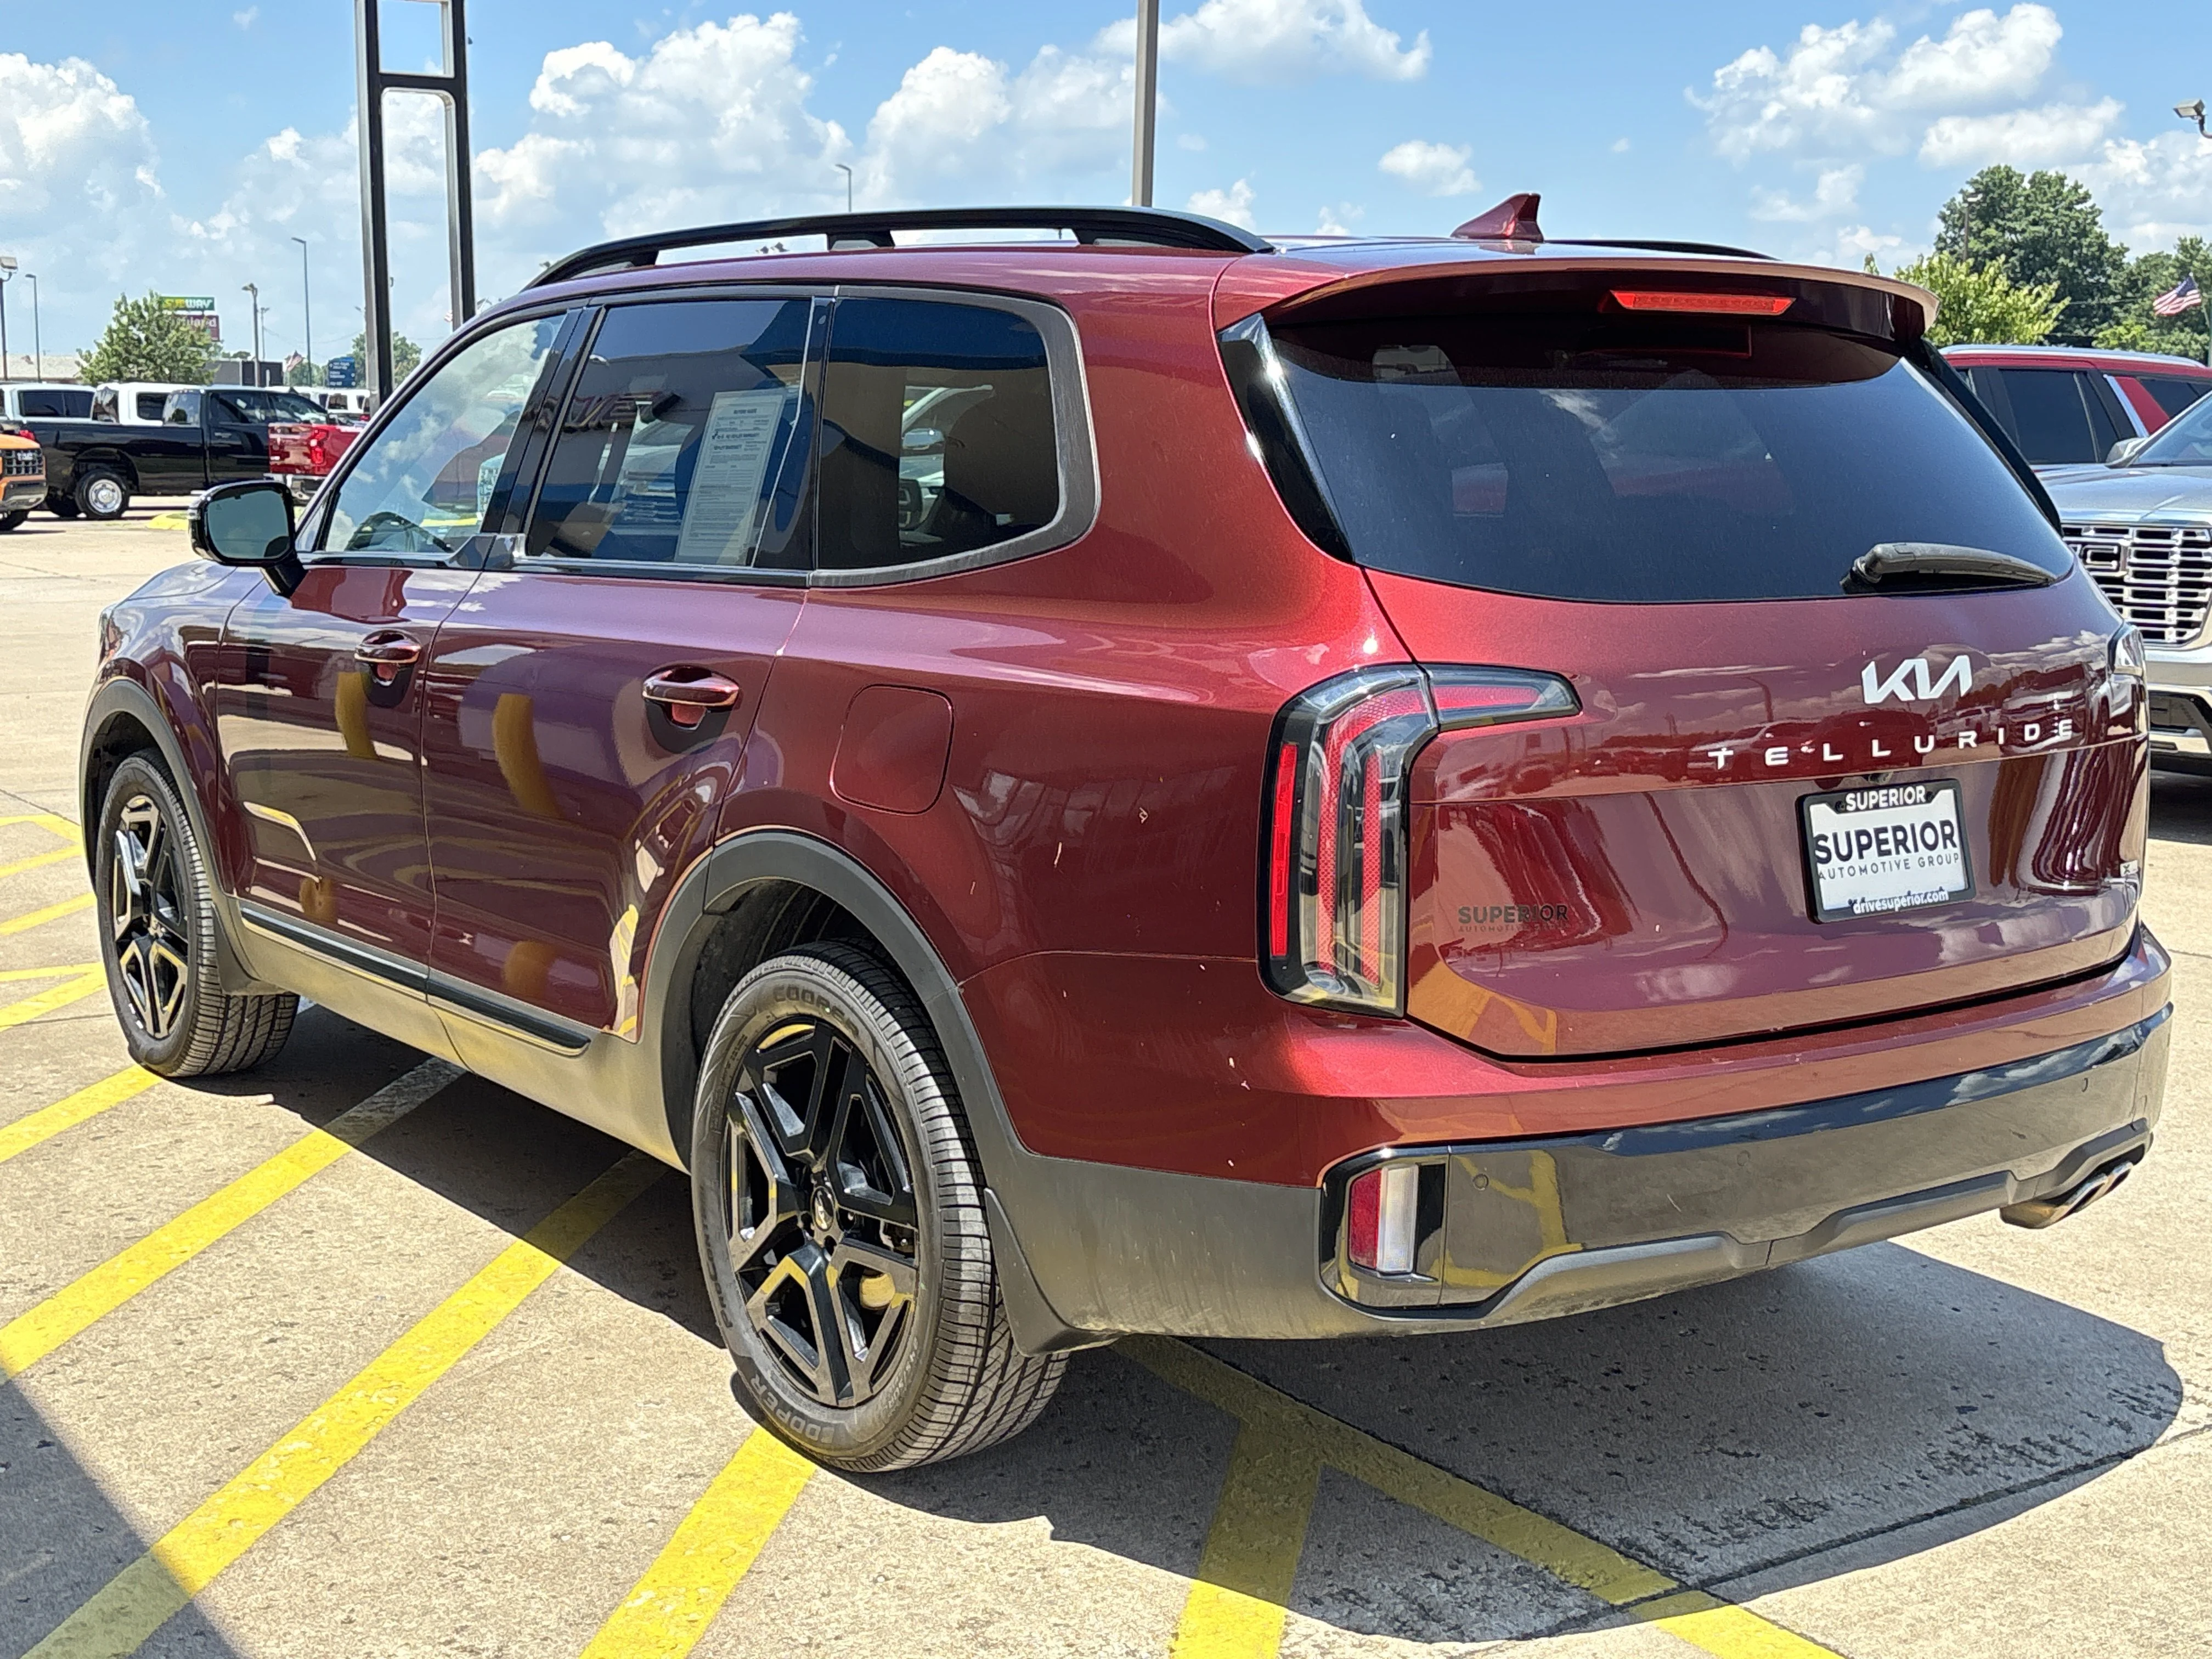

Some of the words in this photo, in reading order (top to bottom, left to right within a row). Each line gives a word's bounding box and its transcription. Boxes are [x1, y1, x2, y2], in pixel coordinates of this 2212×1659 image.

[1862, 654, 1972, 704] KIA
[1707, 719, 2073, 769] TELLURIDE
[1845, 785, 1926, 811] SUPERIOR
[1813, 819, 1957, 865] SUPERIOR
[1818, 858, 1911, 881] AUTOMOTIVE
[1917, 853, 1959, 868] GROUP
[1458, 905, 1568, 924] SUPERIOR
[1852, 889, 1949, 915] drivesuperior.com
[1458, 924, 1530, 933] AUTOMOTIV
[772, 985, 860, 1037] COOPER
[749, 1373, 834, 1444] COOPER
